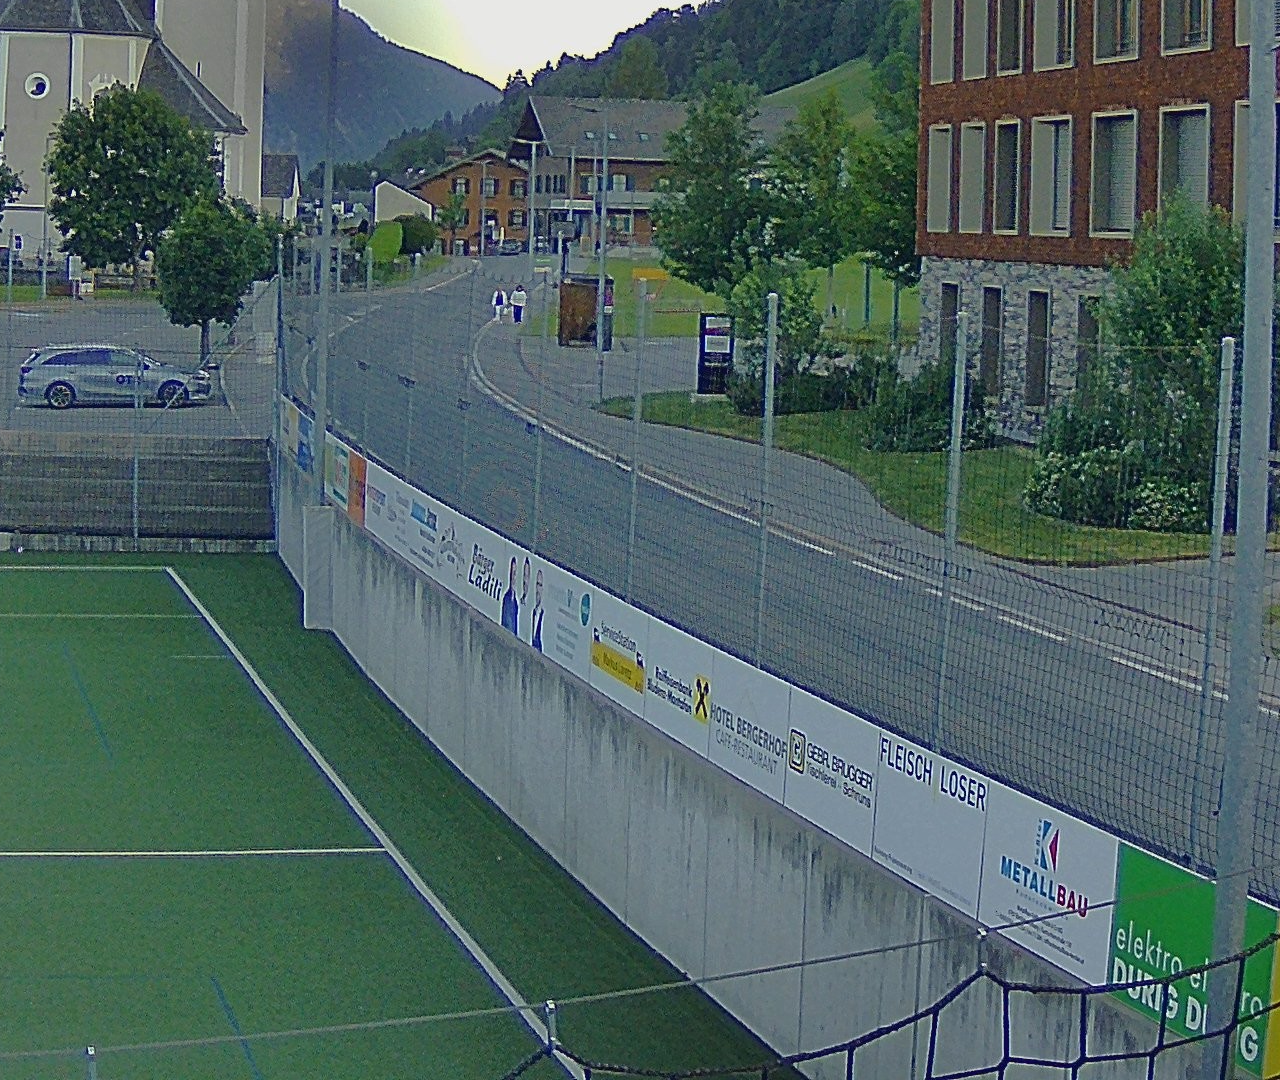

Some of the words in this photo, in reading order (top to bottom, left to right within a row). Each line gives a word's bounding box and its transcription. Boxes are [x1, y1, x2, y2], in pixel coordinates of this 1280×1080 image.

[710, 703, 735, 731] HOTEL
[737, 717, 787, 759] BERGERHOF
[880, 737, 933, 786] FLEISCH
[940, 766, 987, 812] LOSER
[1000, 855, 1088, 918] METALLBAU
[1116, 920, 1182, 976] elektro
